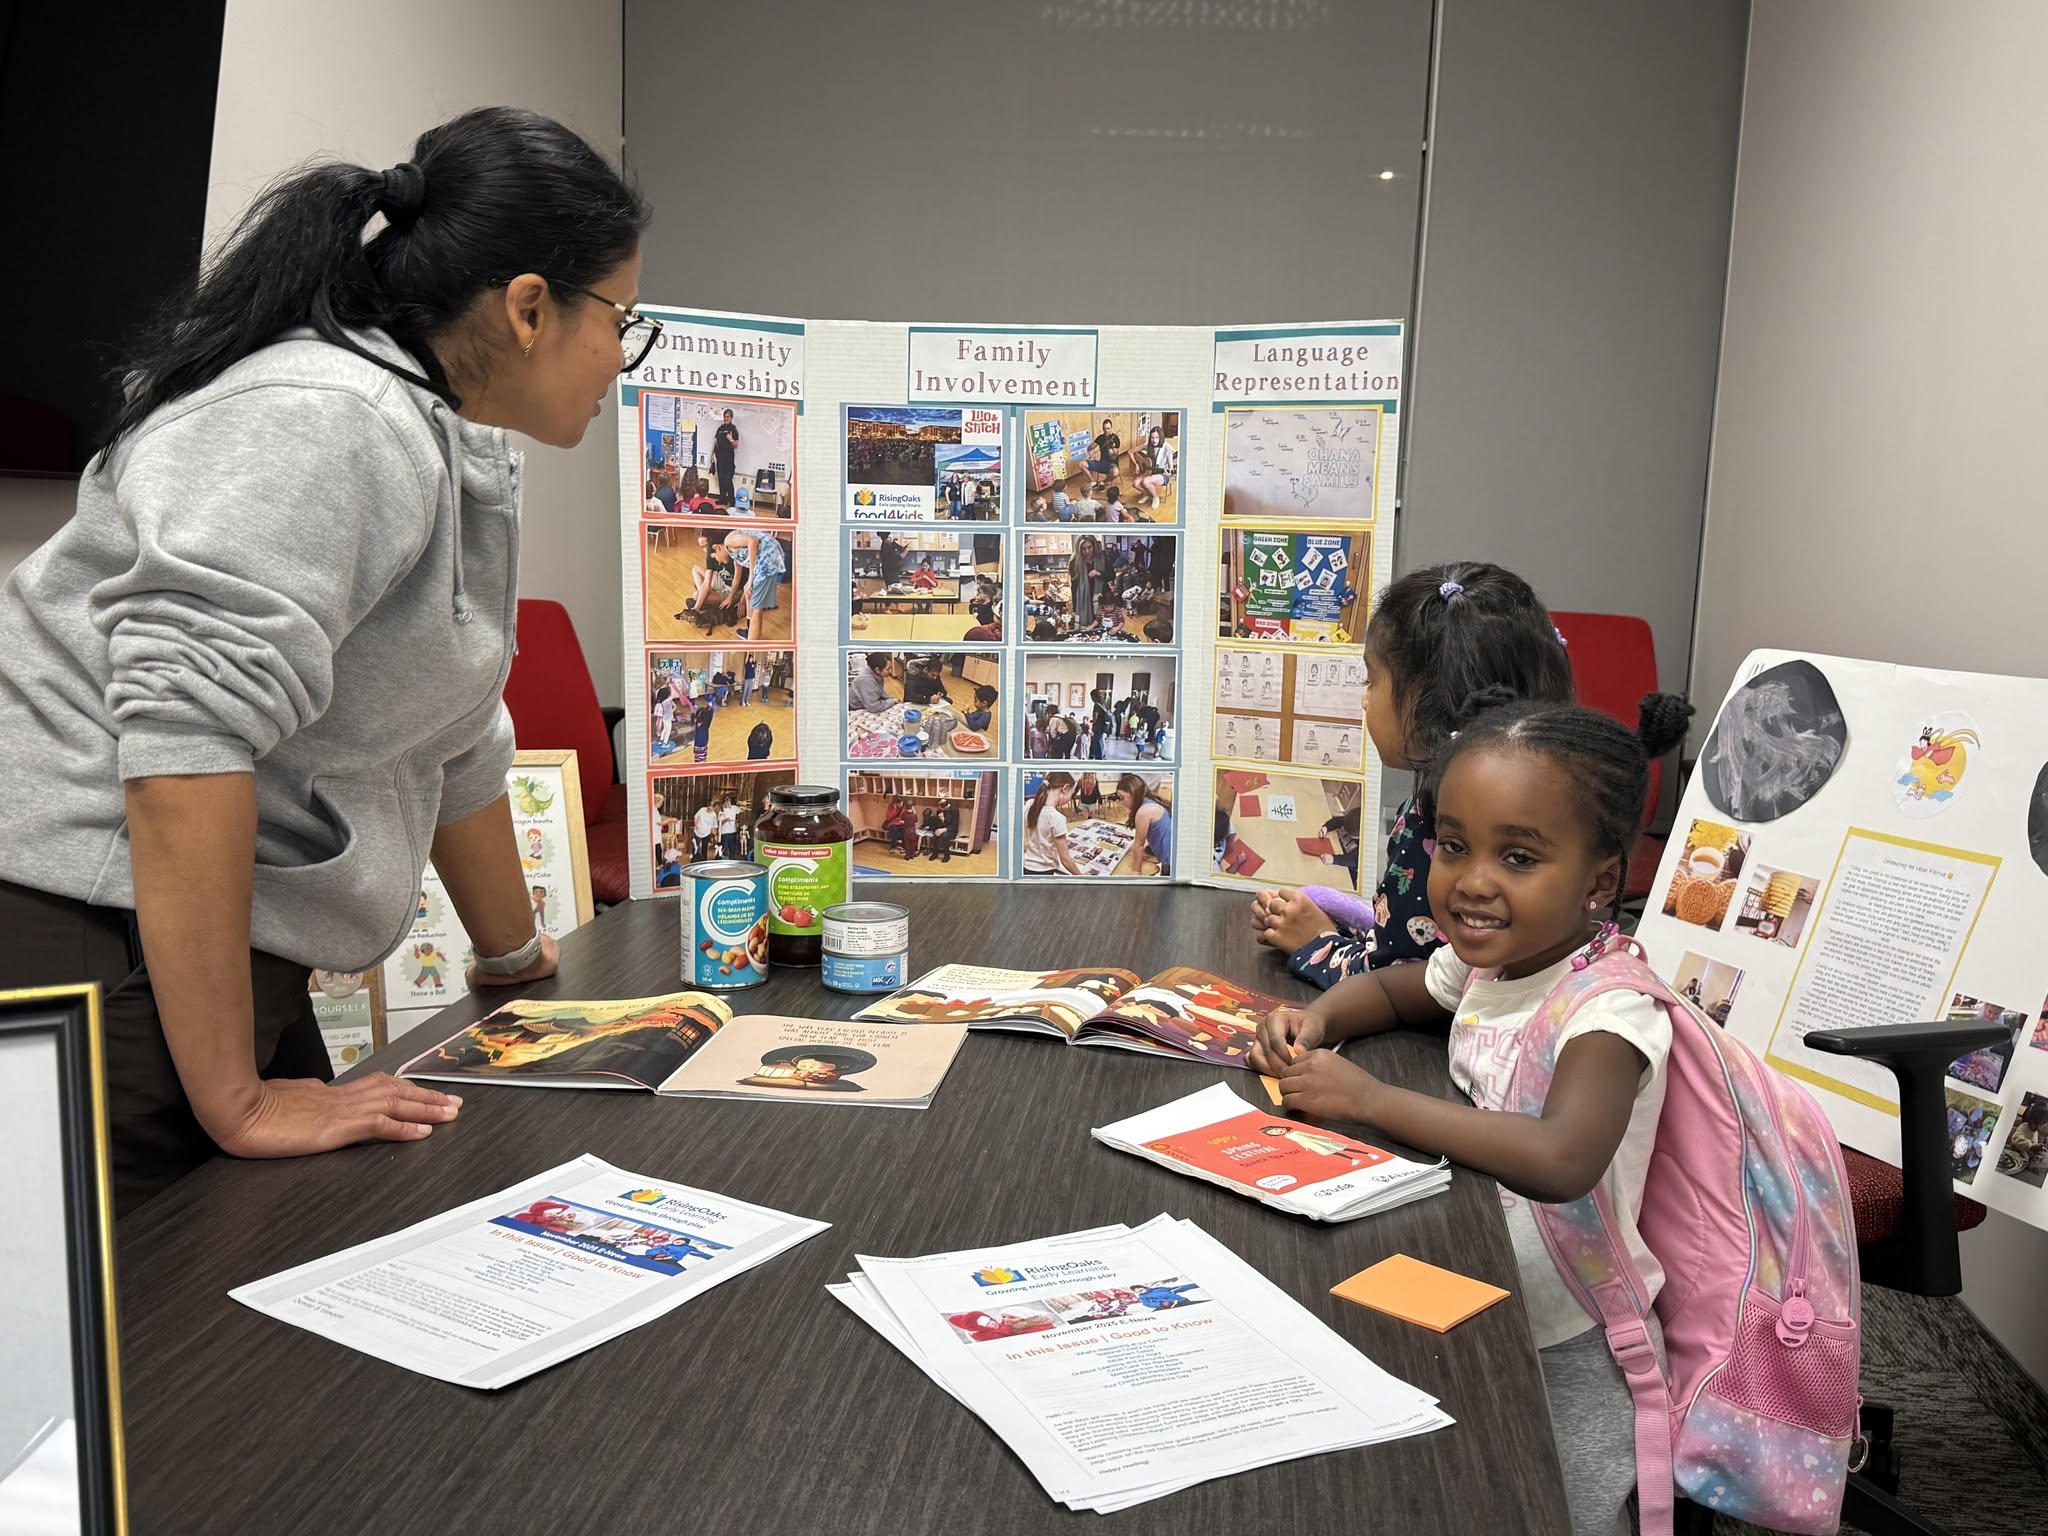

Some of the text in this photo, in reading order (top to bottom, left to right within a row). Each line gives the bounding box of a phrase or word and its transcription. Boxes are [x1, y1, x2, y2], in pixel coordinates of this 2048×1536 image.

[654, 333, 791, 367] ommunity
[956, 339, 1051, 369] Family
[1253, 343, 1369, 369] Language
[914, 370, 1090, 398] Involvement
[1214, 371, 1399, 395] Representation
[1308, 448, 1361, 462] OHANA
[1307, 462, 1360, 475] MEANS
[879, 494, 921, 503] RisingOaks
[1254, 535, 1272, 543] GREEN
[717, 898, 756, 906] compliments
[1229, 1146, 1281, 1161] FESTIVAL
[665, 1199, 727, 1220] RisingOaks
[490, 1229, 645, 1280] In this Issue Good to Know
[1024, 1259, 1103, 1275] RisingOaks
[1031, 1264, 1110, 1281] Early Learning
[985, 1272, 1117, 1296] Growing minds through play
[1042, 1325, 1093, 1340] November
[1119, 1315, 1157, 1326] E-News
[1006, 1318, 1213, 1361] In this Issue Good to Know
